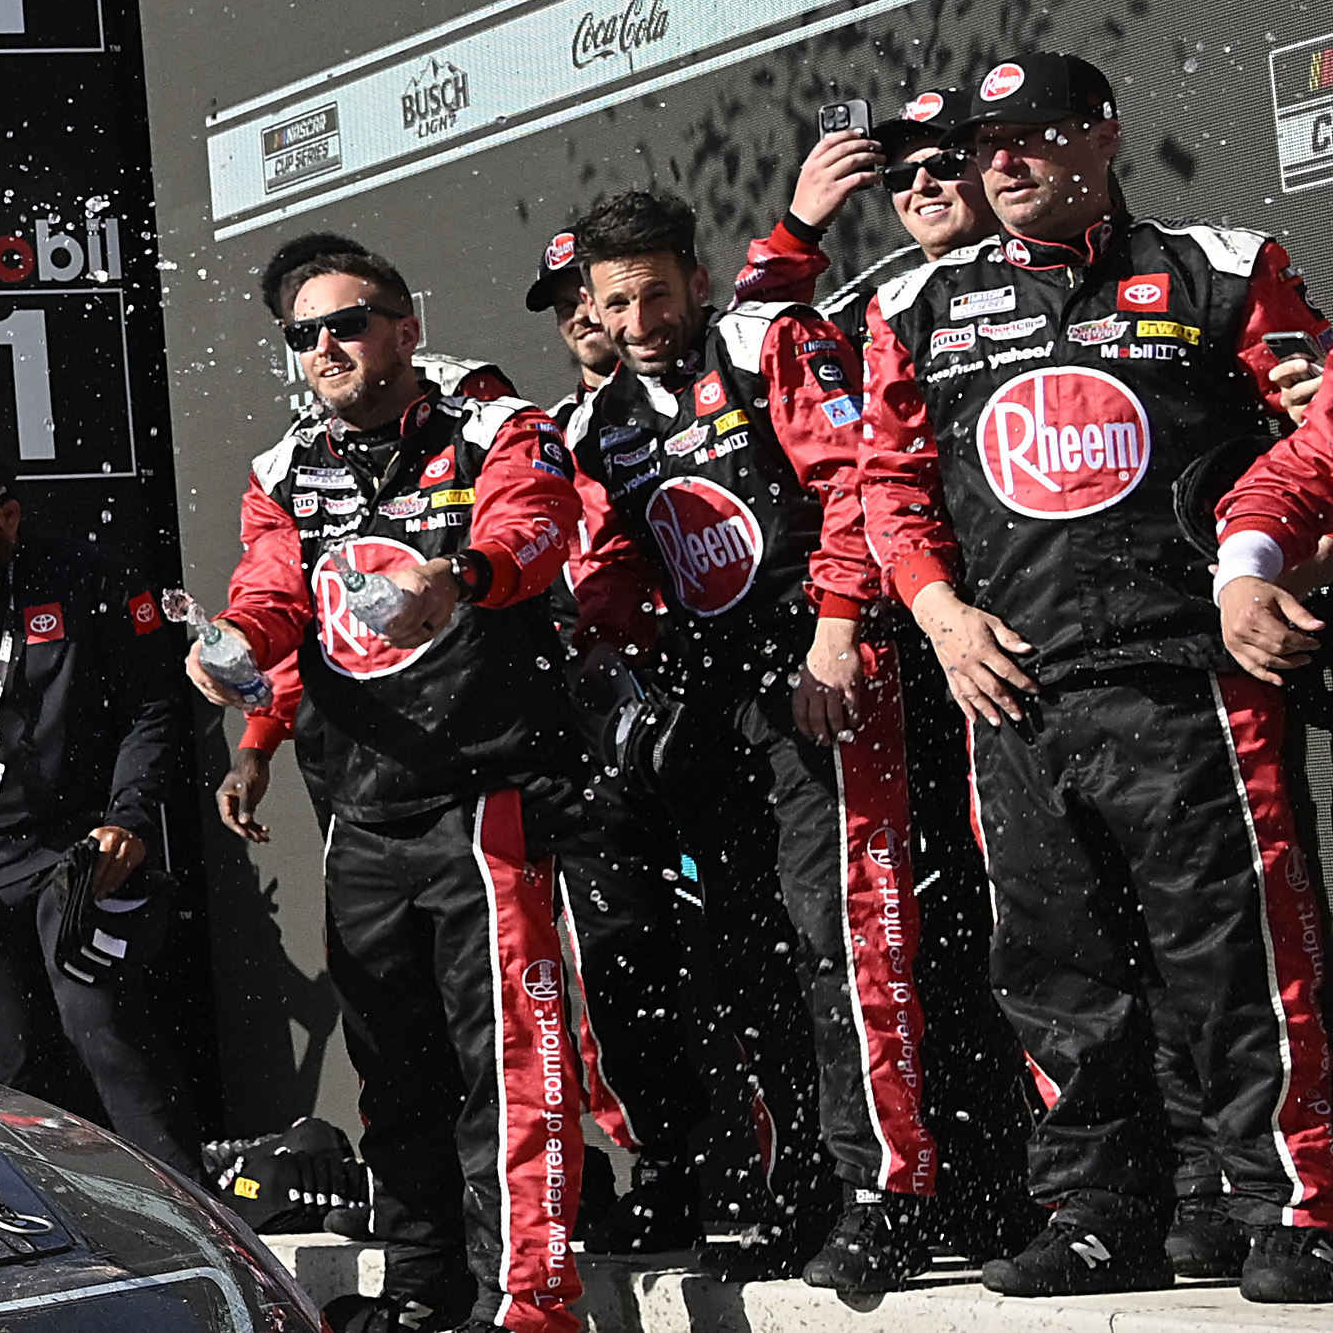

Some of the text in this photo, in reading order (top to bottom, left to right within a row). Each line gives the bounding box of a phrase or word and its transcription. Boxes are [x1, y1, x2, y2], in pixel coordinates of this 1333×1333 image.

[401, 72, 470, 129] BUSCH
[988, 342, 1054, 369] yahoo!
[1101, 345, 1153, 359] Mobil
[994, 376, 1141, 496] Rheem
[694, 439, 733, 465] Mobil
[406, 513, 447, 533] Mobil
[887, 980, 910, 1004] of
[534, 1011, 567, 1308] Te new degree of comfort.
